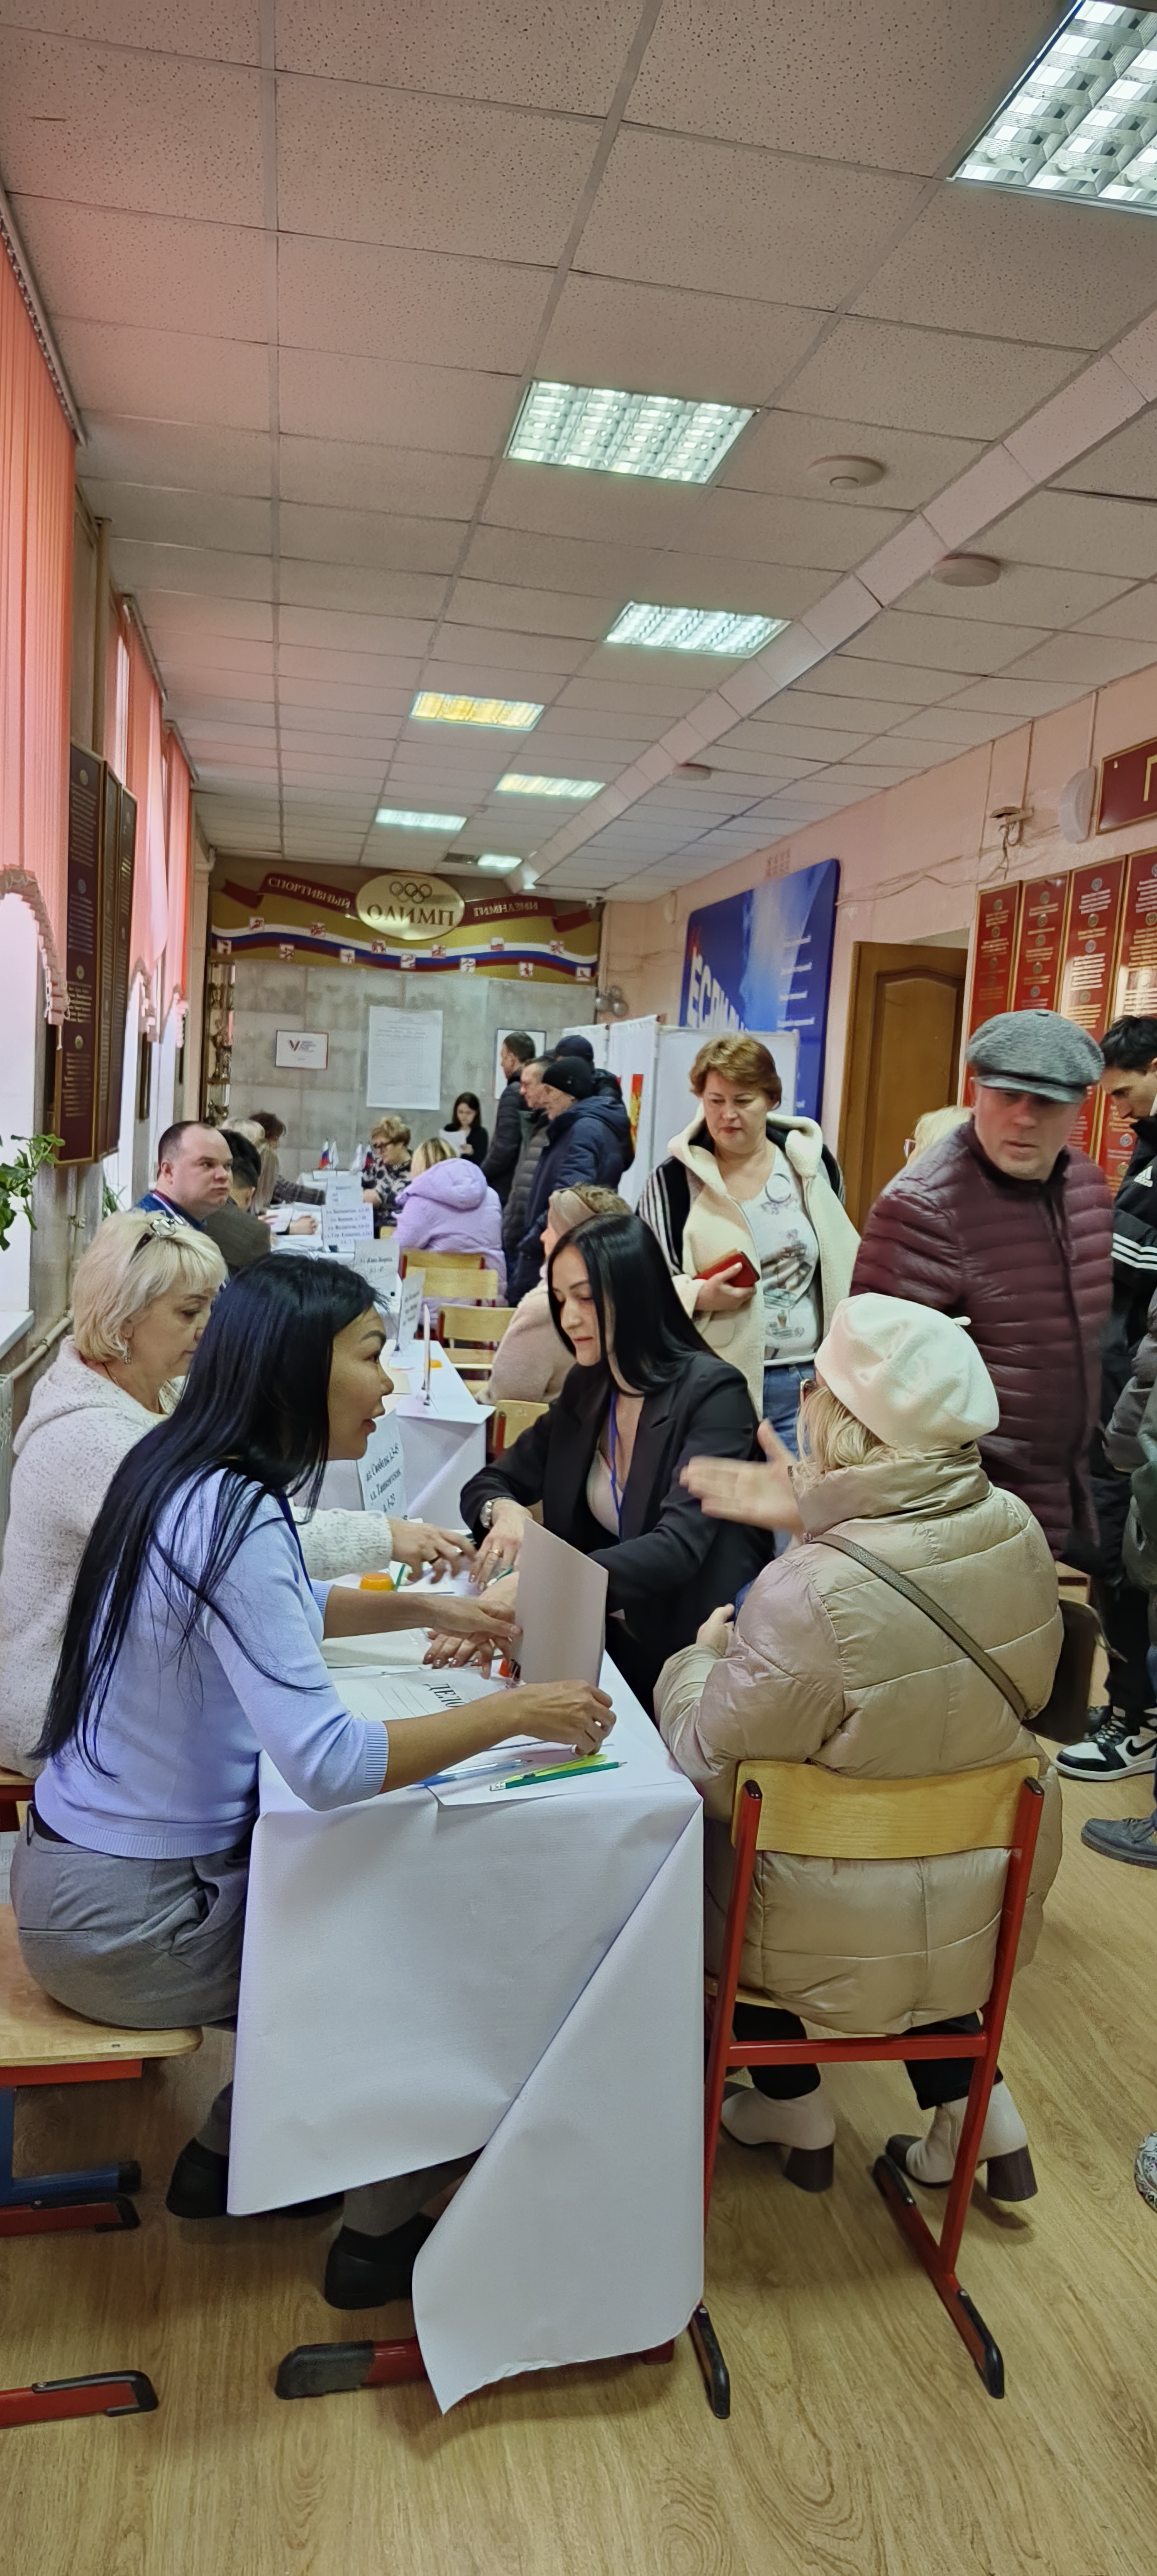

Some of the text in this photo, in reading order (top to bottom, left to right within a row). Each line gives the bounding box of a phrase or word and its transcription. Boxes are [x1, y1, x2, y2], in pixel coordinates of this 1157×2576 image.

[268, 878, 351, 908] СПОРТИВНЫЙ
[367, 904, 454, 926] ОЛИМП
[421, 1683, 466, 1707] ДЕЛО
